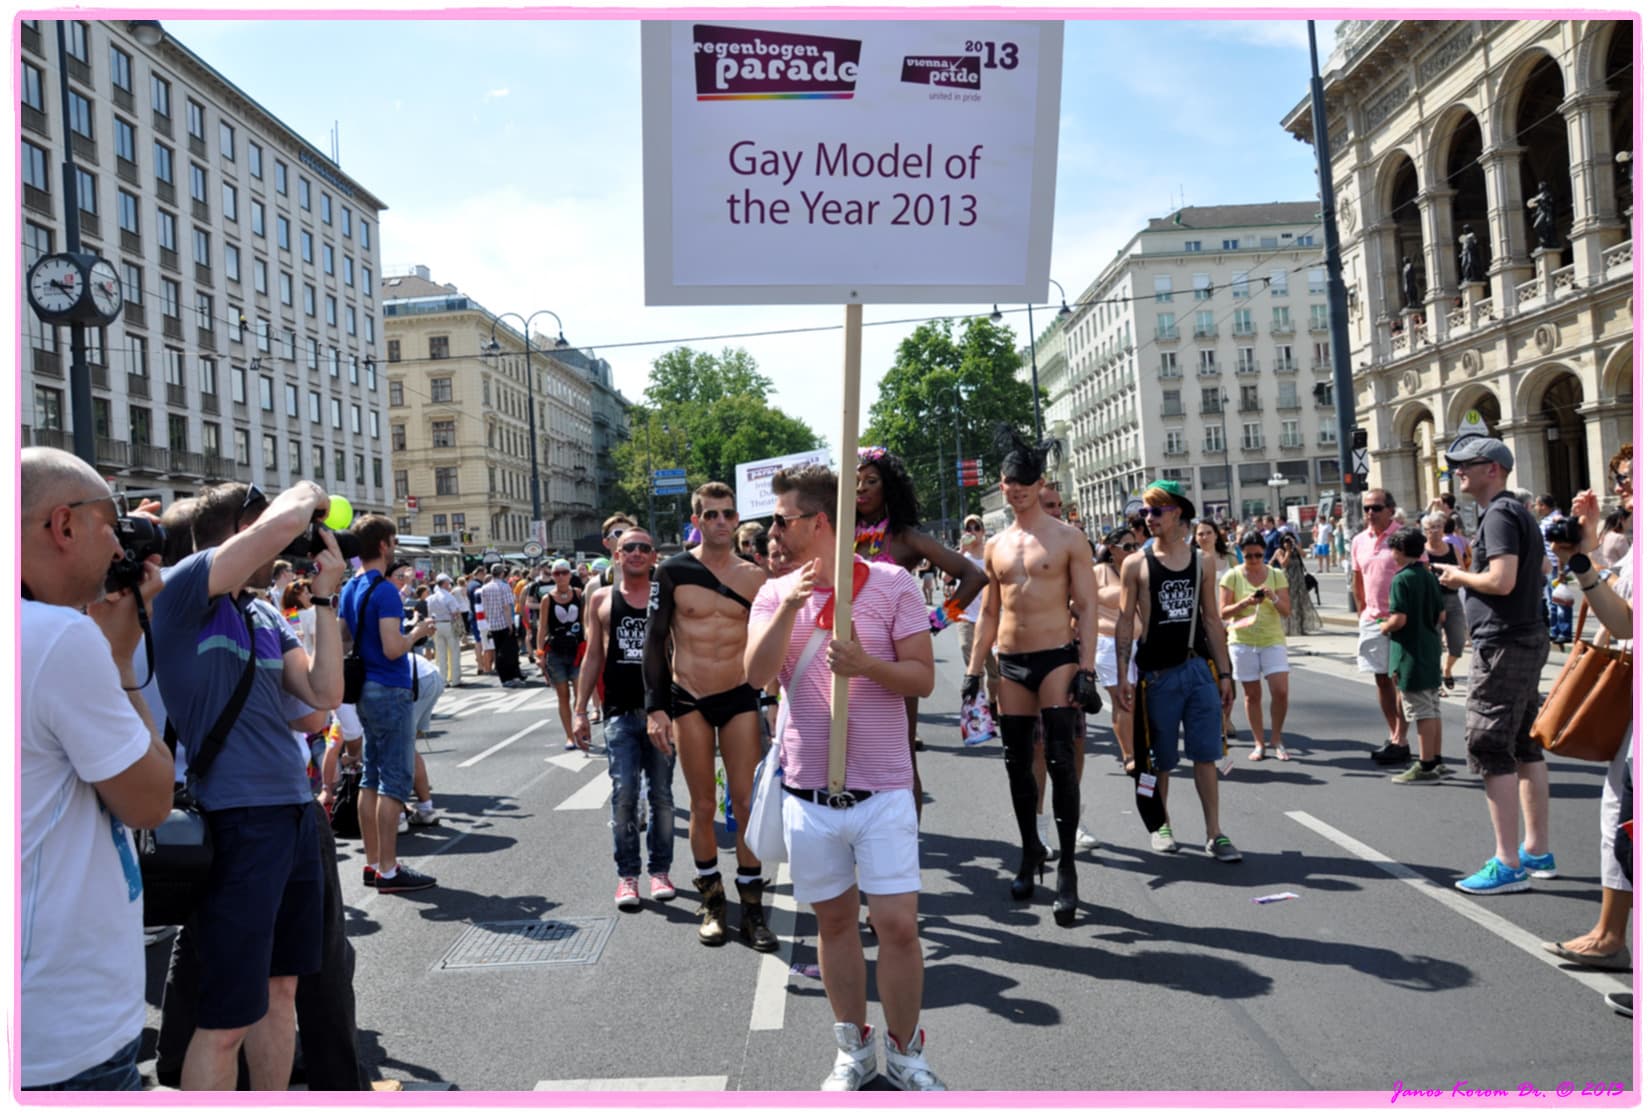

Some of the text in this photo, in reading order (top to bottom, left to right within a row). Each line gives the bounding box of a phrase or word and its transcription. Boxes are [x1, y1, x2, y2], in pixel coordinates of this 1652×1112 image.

[693, 38, 820, 60] regenbogen
[715, 51, 859, 90] parade
[906, 59, 949, 68] vienna
[929, 67, 979, 86] pride
[929, 92, 982, 103] united in pride
[729, 140, 983, 185] Gay Model of
[726, 189, 978, 227] the Year 2013
[1162, 580, 1190, 592] GAY
[621, 616, 647, 630] GAY
[626, 649, 643, 659] 201
